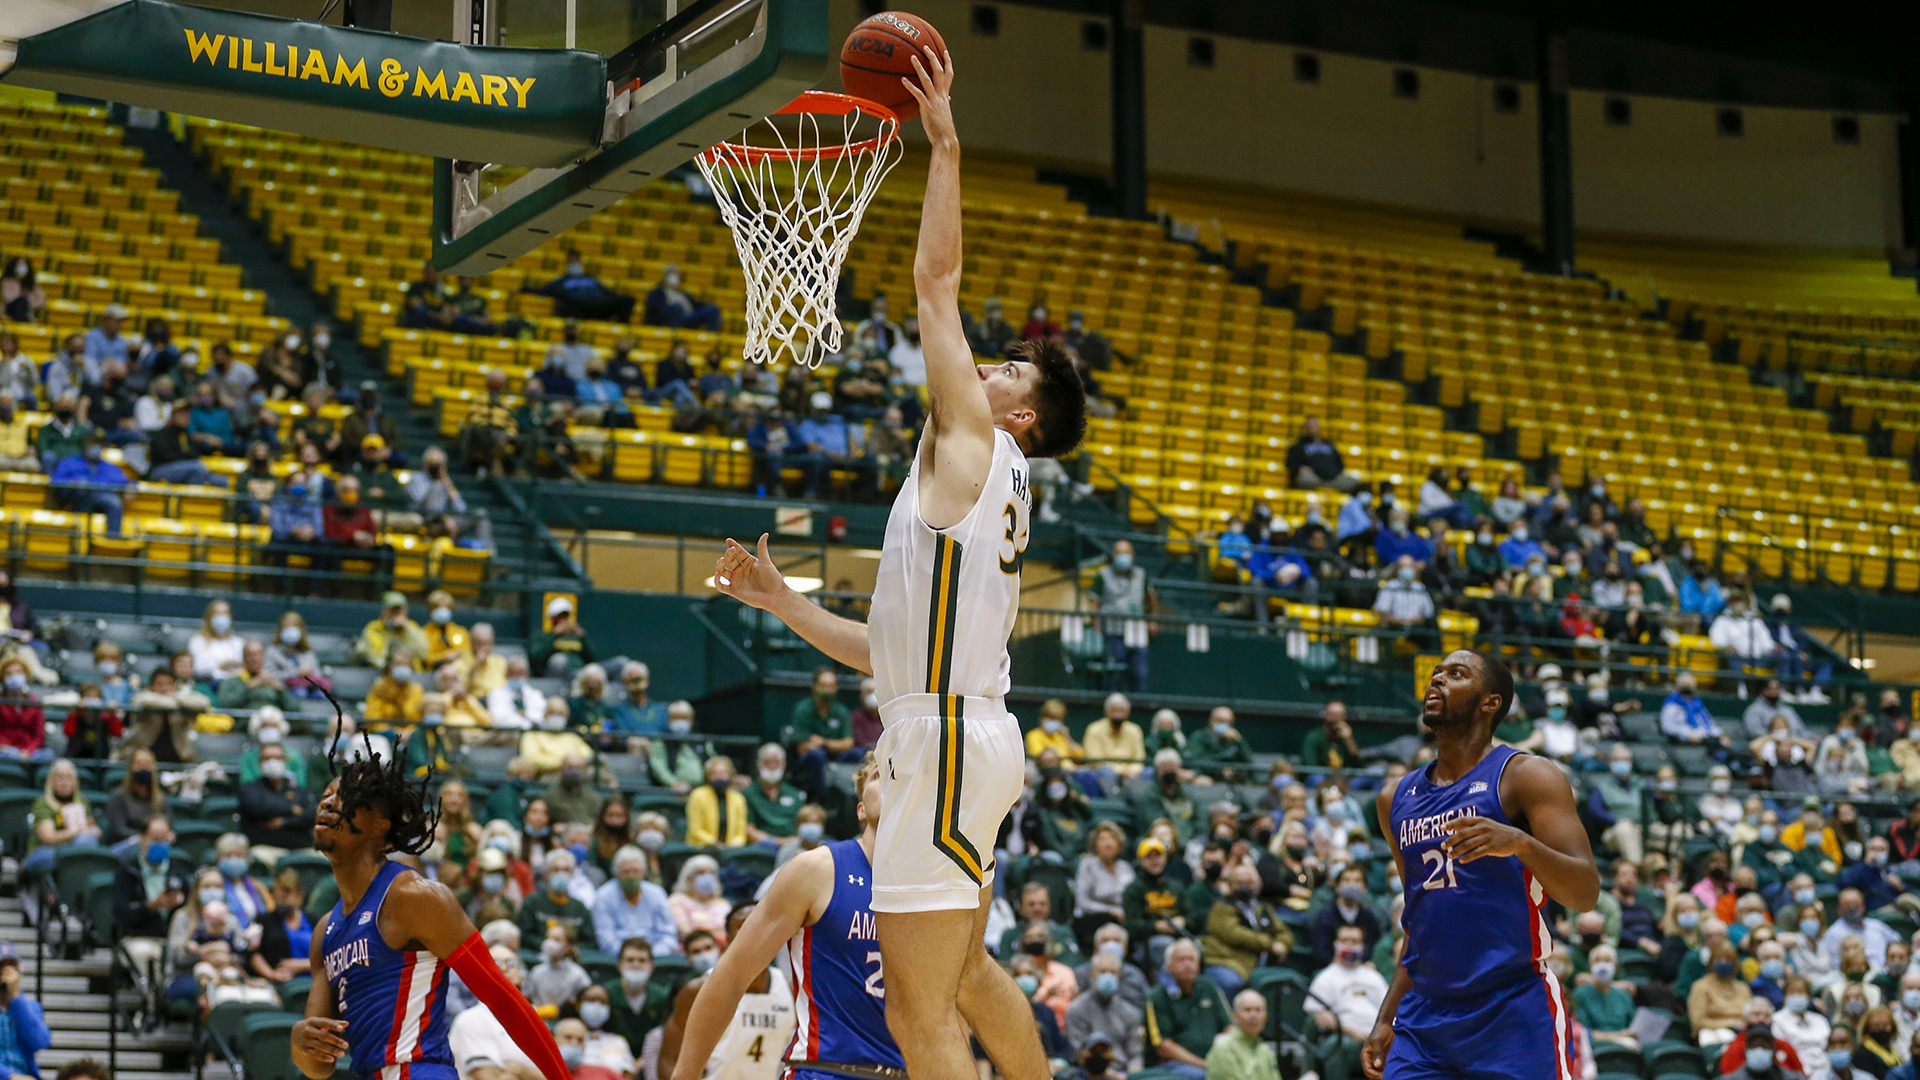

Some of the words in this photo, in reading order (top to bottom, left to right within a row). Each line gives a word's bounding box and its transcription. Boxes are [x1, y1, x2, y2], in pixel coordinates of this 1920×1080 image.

[848, 36, 895, 58] NCAA
[184, 28, 370, 90] WILLIAM
[378, 57, 410, 98] &
[411, 65, 537, 109] MARY
[1421, 846, 1458, 891] 21
[324, 938, 370, 981] MERICAN
[742, 1012, 776, 1029] TRIBE
[747, 1034, 764, 1063] 4
